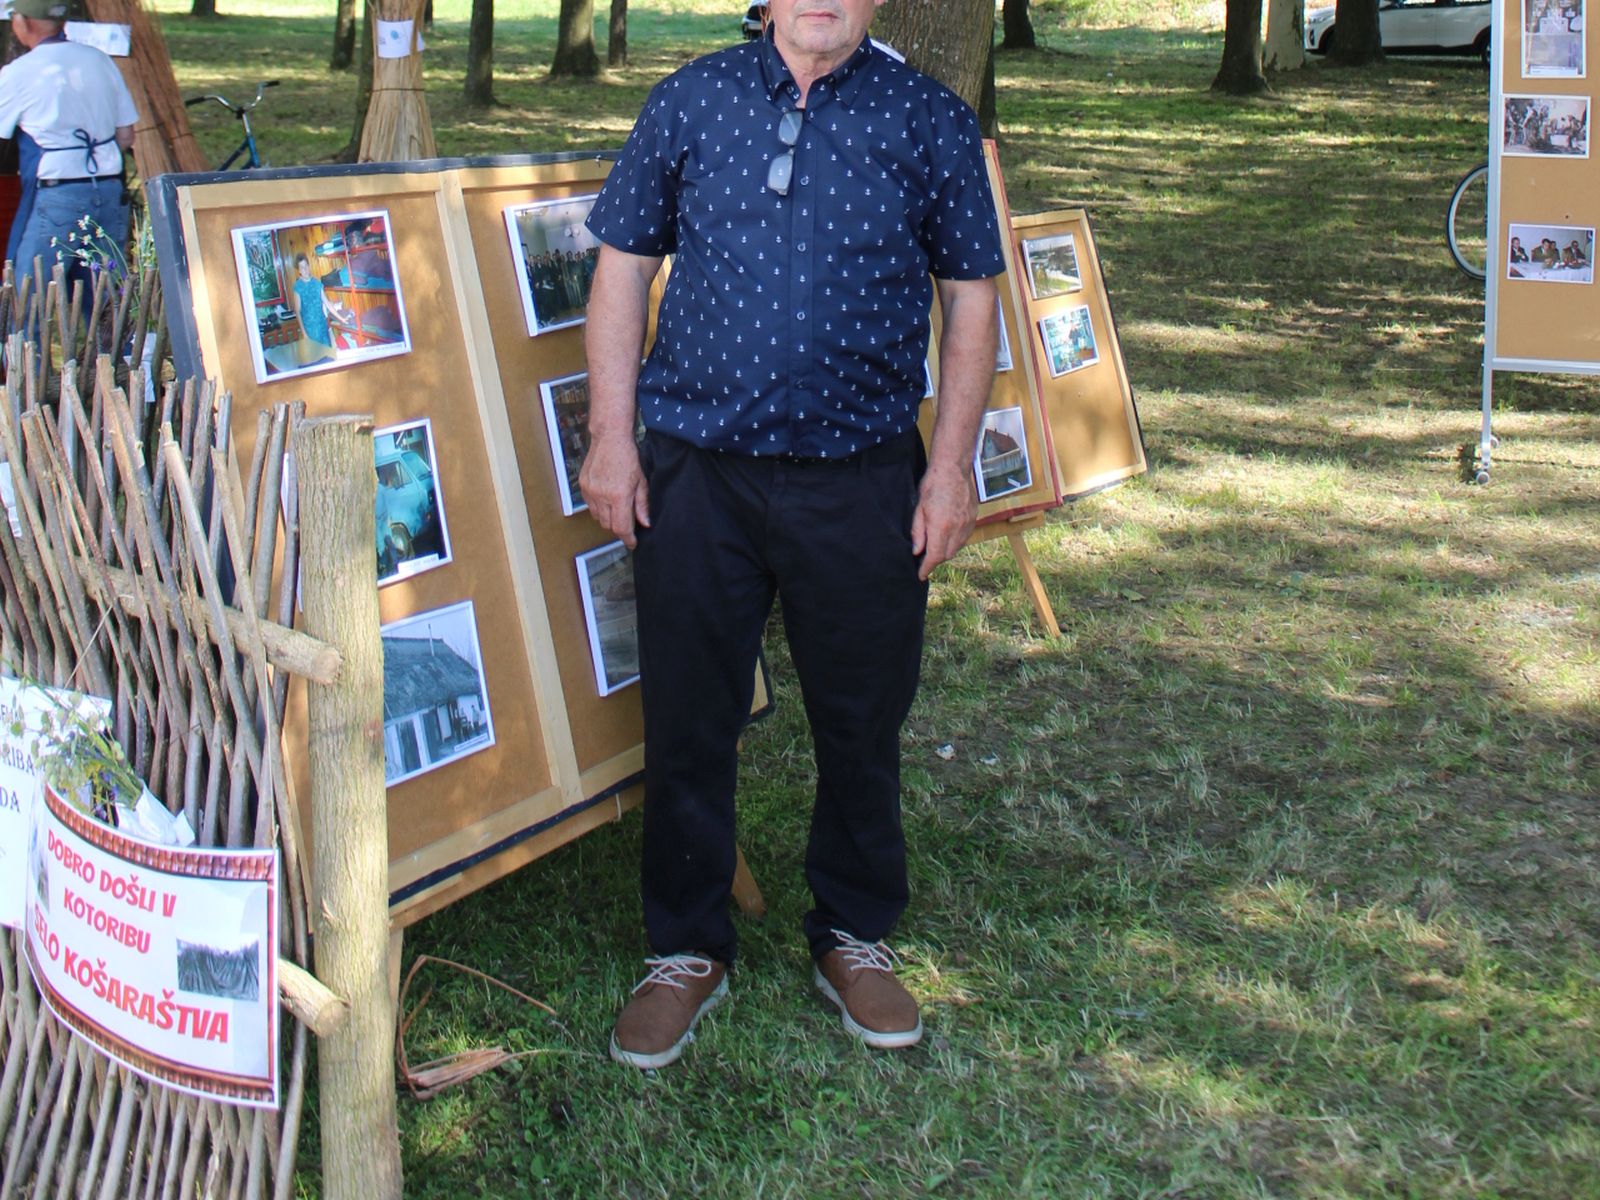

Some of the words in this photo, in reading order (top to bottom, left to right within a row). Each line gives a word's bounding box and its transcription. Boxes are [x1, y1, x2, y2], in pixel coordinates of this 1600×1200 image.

[48, 829, 95, 883] DOBRO
[99, 870, 156, 912] DOŠLI
[162, 893, 177, 918] V
[63, 887, 151, 954] KOTORIBU
[34, 903, 60, 961] SELO
[63, 945, 229, 1044] KOŠARAŠTVA
